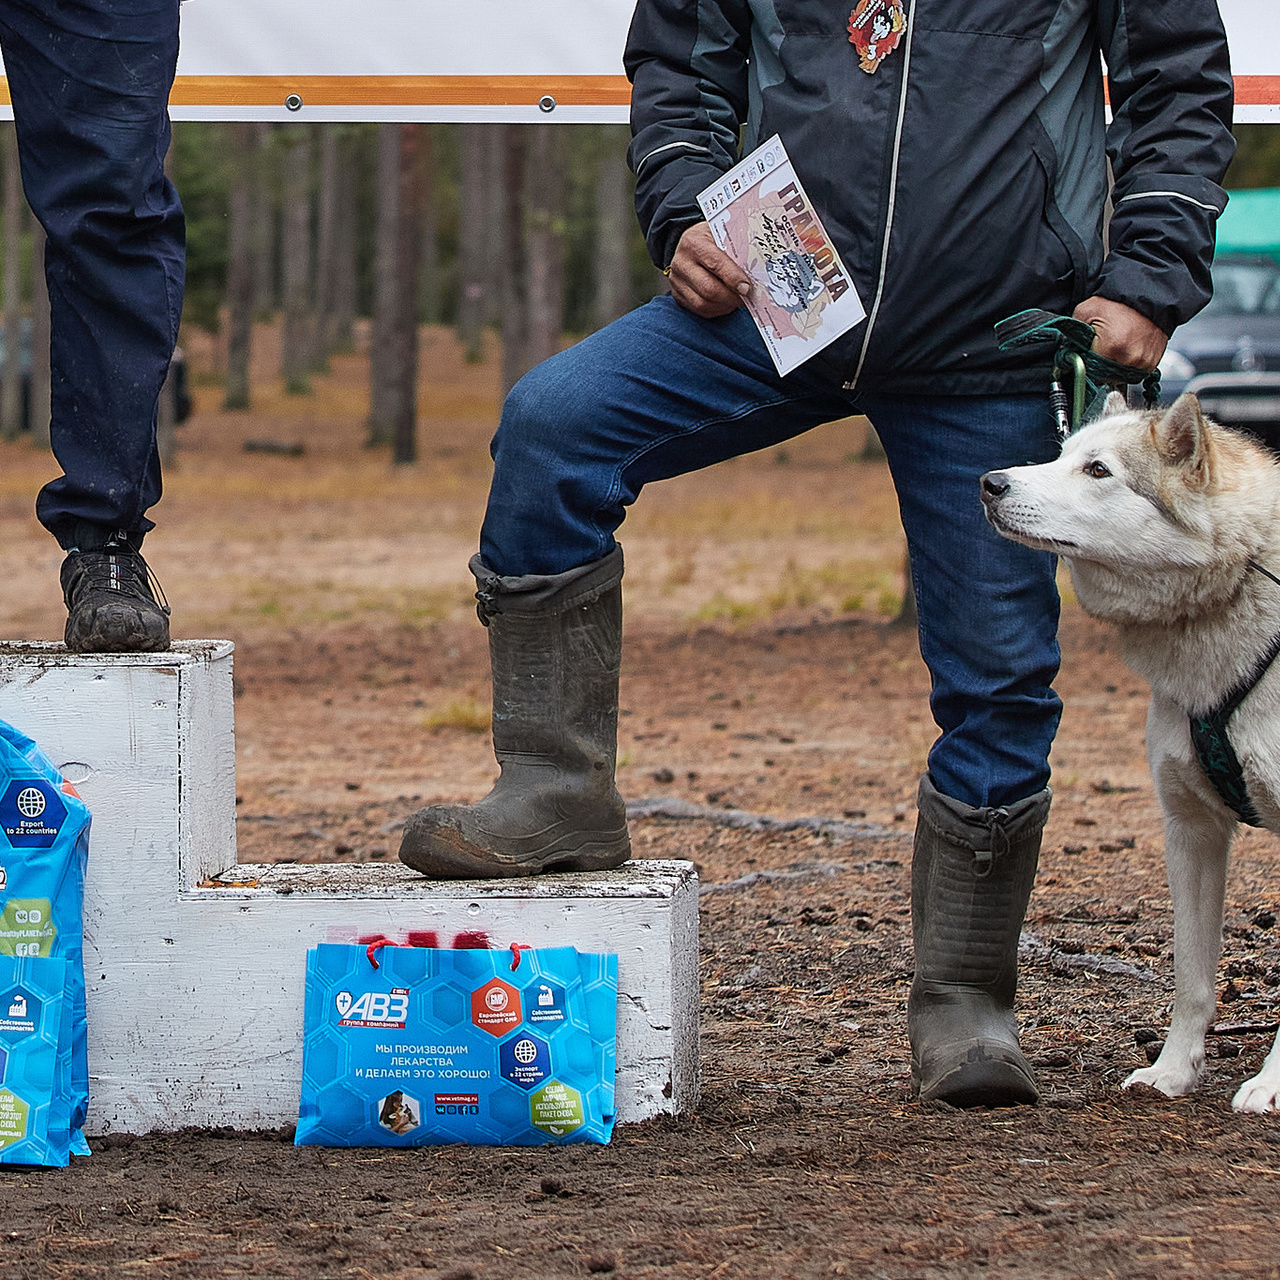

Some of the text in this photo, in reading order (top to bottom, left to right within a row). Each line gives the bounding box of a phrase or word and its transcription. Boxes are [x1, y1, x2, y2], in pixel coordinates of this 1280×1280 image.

[867, 44, 877, 60] 3
[781, 214, 801, 247] ОСЕНЬ
[776, 182, 850, 302] ГРАМОТА
[20, 820, 44, 829] Export
[343, 993, 409, 1022] АВЗ
[375, 1044, 468, 1055] МЫ ПРОИЗВОДИМ
[390, 1057, 453, 1066] ЛЕКАРСТВА
[355, 1068, 490, 1079] И ДЕЛАЕМ ЭТО ХОРОШО!
